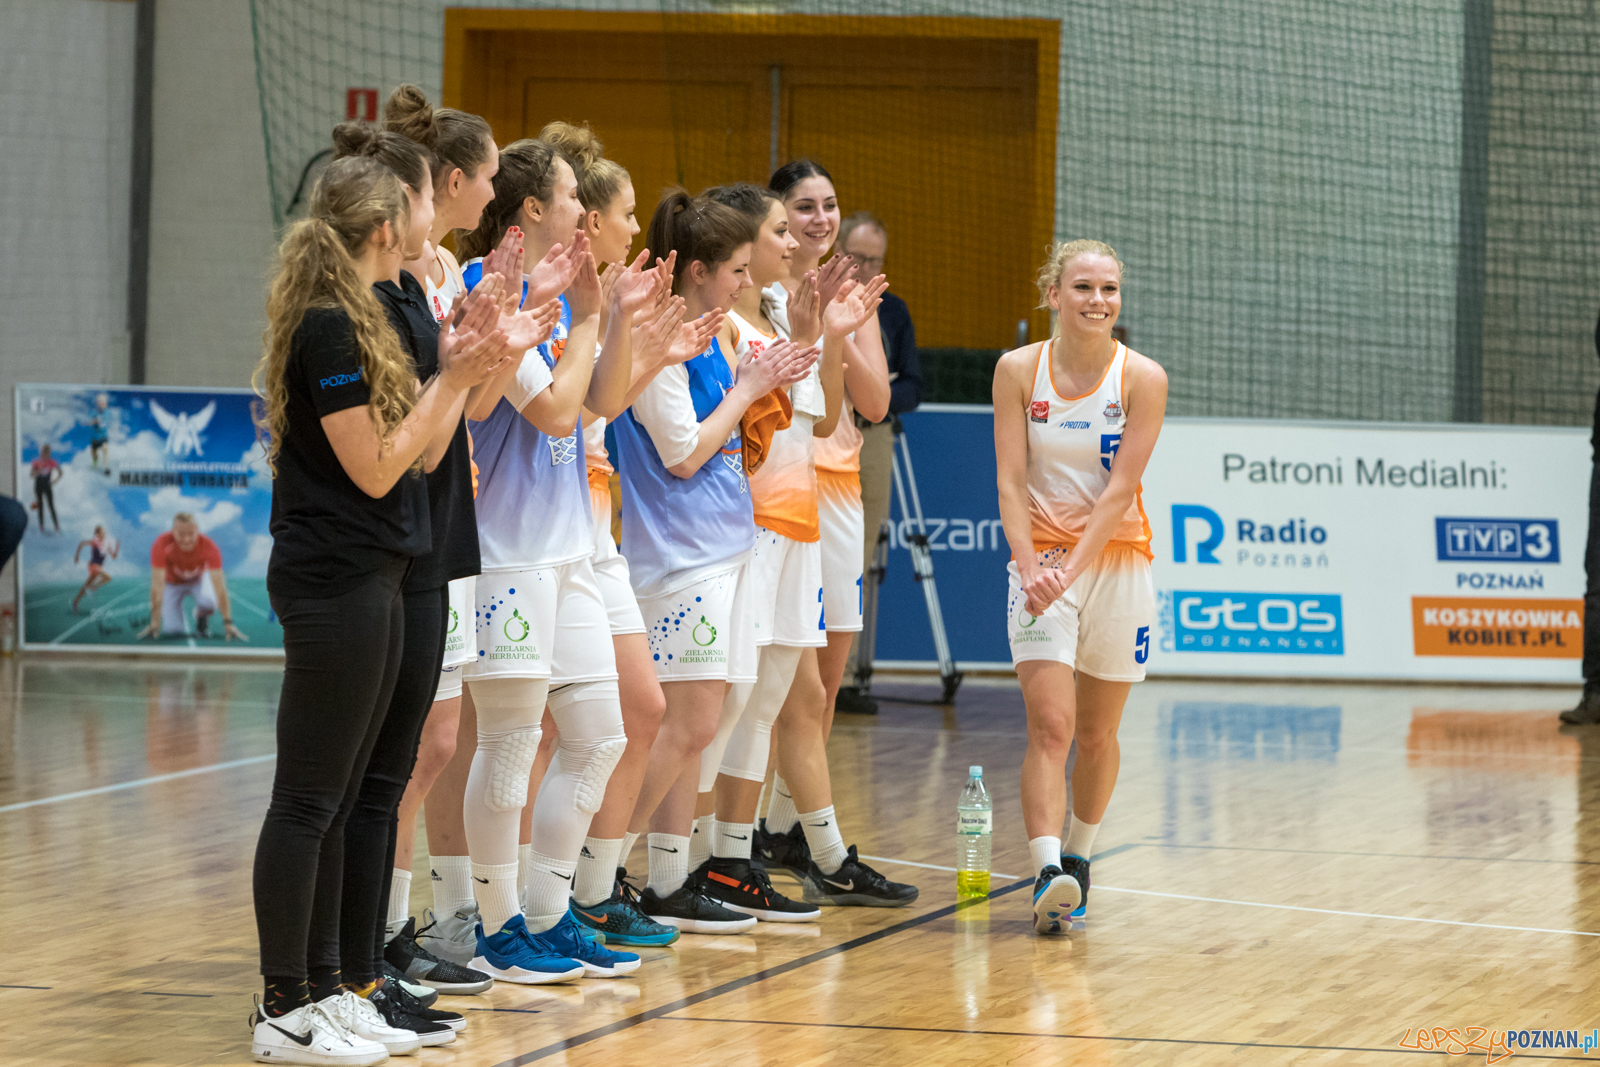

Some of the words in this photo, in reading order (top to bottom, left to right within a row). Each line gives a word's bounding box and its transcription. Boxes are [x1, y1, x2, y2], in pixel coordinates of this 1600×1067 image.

[1064, 421, 1091, 429] PROTON
[1222, 453, 1343, 485] Patroni
[1355, 456, 1507, 489] Medialni:
[1237, 517, 1328, 544] Radio
[1237, 548, 1329, 568] Poznań
[1456, 569, 1544, 590] POZNAŃ
[1423, 608, 1581, 628] KOSZYKOWKA
[1135, 625, 1150, 664] 5
[1448, 629, 1567, 647] KOBIET.PL
[489, 652, 541, 661] HERBAFLORIS
[495, 645, 537, 653] ZIELARNIA
[679, 656, 727, 664] HERBAFLORIS
